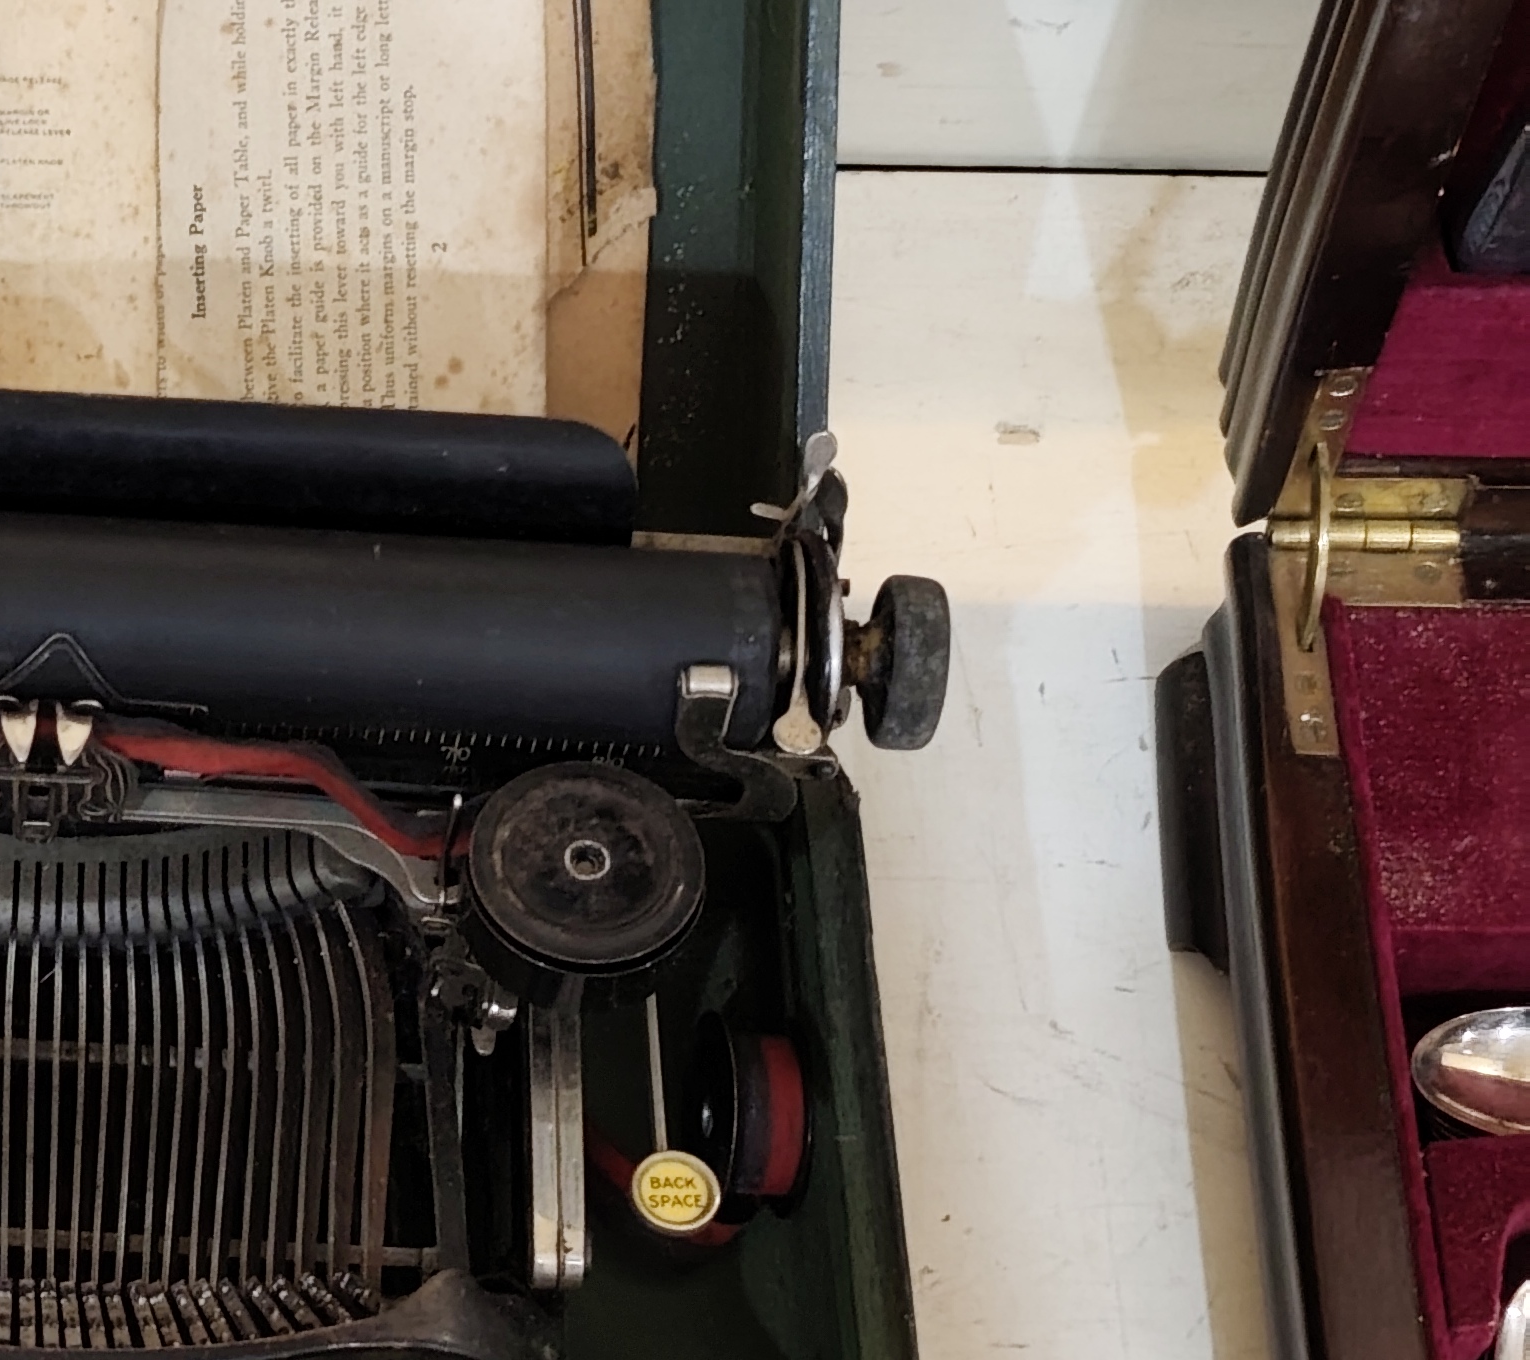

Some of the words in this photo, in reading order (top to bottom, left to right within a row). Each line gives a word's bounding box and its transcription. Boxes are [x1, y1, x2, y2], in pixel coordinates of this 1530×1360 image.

[327, 6, 342, 18] it
[350, 6, 368, 42] edge
[280, 18, 299, 73] exactly
[350, 48, 366, 75] left
[375, 33, 392, 68] long
[230, 50, 248, 94] while
[282, 81, 298, 96] in
[304, 52, 323, 114] Margin
[378, 75, 390, 92] or
[328, 80, 344, 108] left
[352, 82, 368, 106] the
[402, 84, 416, 122] stop.
[232, 100, 248, 130] and
[286, 104, 302, 147] paper
[352, 112, 368, 134] for
[306, 121, 322, 146] the
[330, 118, 344, 153] with
[376, 98, 393, 184] manuscript
[233, 135, 250, 188] Table,
[283, 156, 298, 176] all
[312, 156, 322, 175] on
[352, 142, 371, 183] guide
[400, 128, 417, 184] margin
[284, 184, 300, 200] of
[334, 162, 349, 190] you
[188, 184, 206, 236] Paper
[358, 190, 368, 199] a
[358, 204, 369, 220] as
[382, 192, 392, 200] a
[400, 190, 416, 214] the
[235, 194, 252, 238] Paper
[264, 220, 273, 229] a
[308, 184, 330, 252] provided
[331, 200, 346, 255] toward
[382, 208, 393, 226] on
[258, 235, 275, 278] Knob
[286, 208, 302, 276] inserting
[356, 226, 370, 255] acts
[403, 221, 418, 288] resetting
[431, 242, 447, 253] 2
[236, 246, 251, 274] and
[309, 260, 324, 272] is
[355, 262, 370, 274] it
[381, 232, 398, 295] margins
[189, 244, 207, 319] Inserting
[286, 284, 302, 308] the
[332, 264, 348, 302] lever
[237, 281, 253, 330] Platen
[259, 285, 276, 335] Platen
[310, 280, 328, 323] guide
[355, 280, 371, 326] where
[334, 311, 348, 340] this
[381, 301, 396, 366] uniform
[403, 295, 418, 356] without
[261, 343, 277, 366] the
[288, 316, 304, 384] facilitate
[313, 332, 329, 375] paper
[356, 332, 376, 392] position
[239, 338, 254, 400] between
[316, 383, 326, 392] a
[648, 1192, 706, 1209] SPACE
[649, 1175, 699, 1191] BACK
